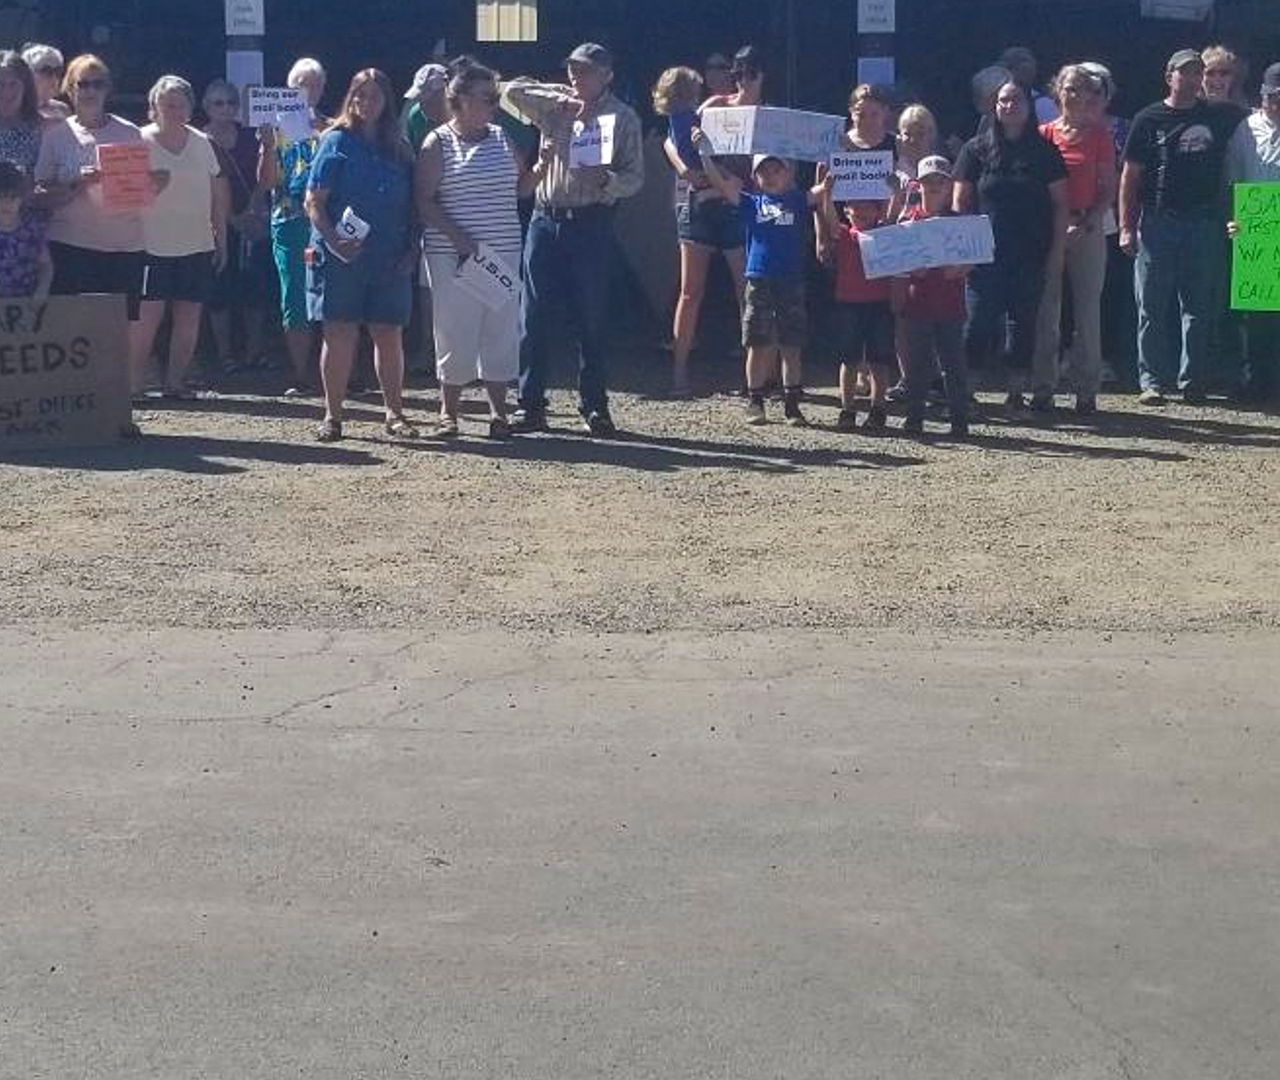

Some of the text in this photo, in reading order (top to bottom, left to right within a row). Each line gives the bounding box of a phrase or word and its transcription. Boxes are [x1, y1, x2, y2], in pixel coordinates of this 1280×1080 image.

[252, 90, 280, 100] Bring
[252, 102, 276, 112] mail
[833, 157, 883, 168] Bring our
[833, 172, 858, 181] mail
[1238, 243, 1263, 261] WE
